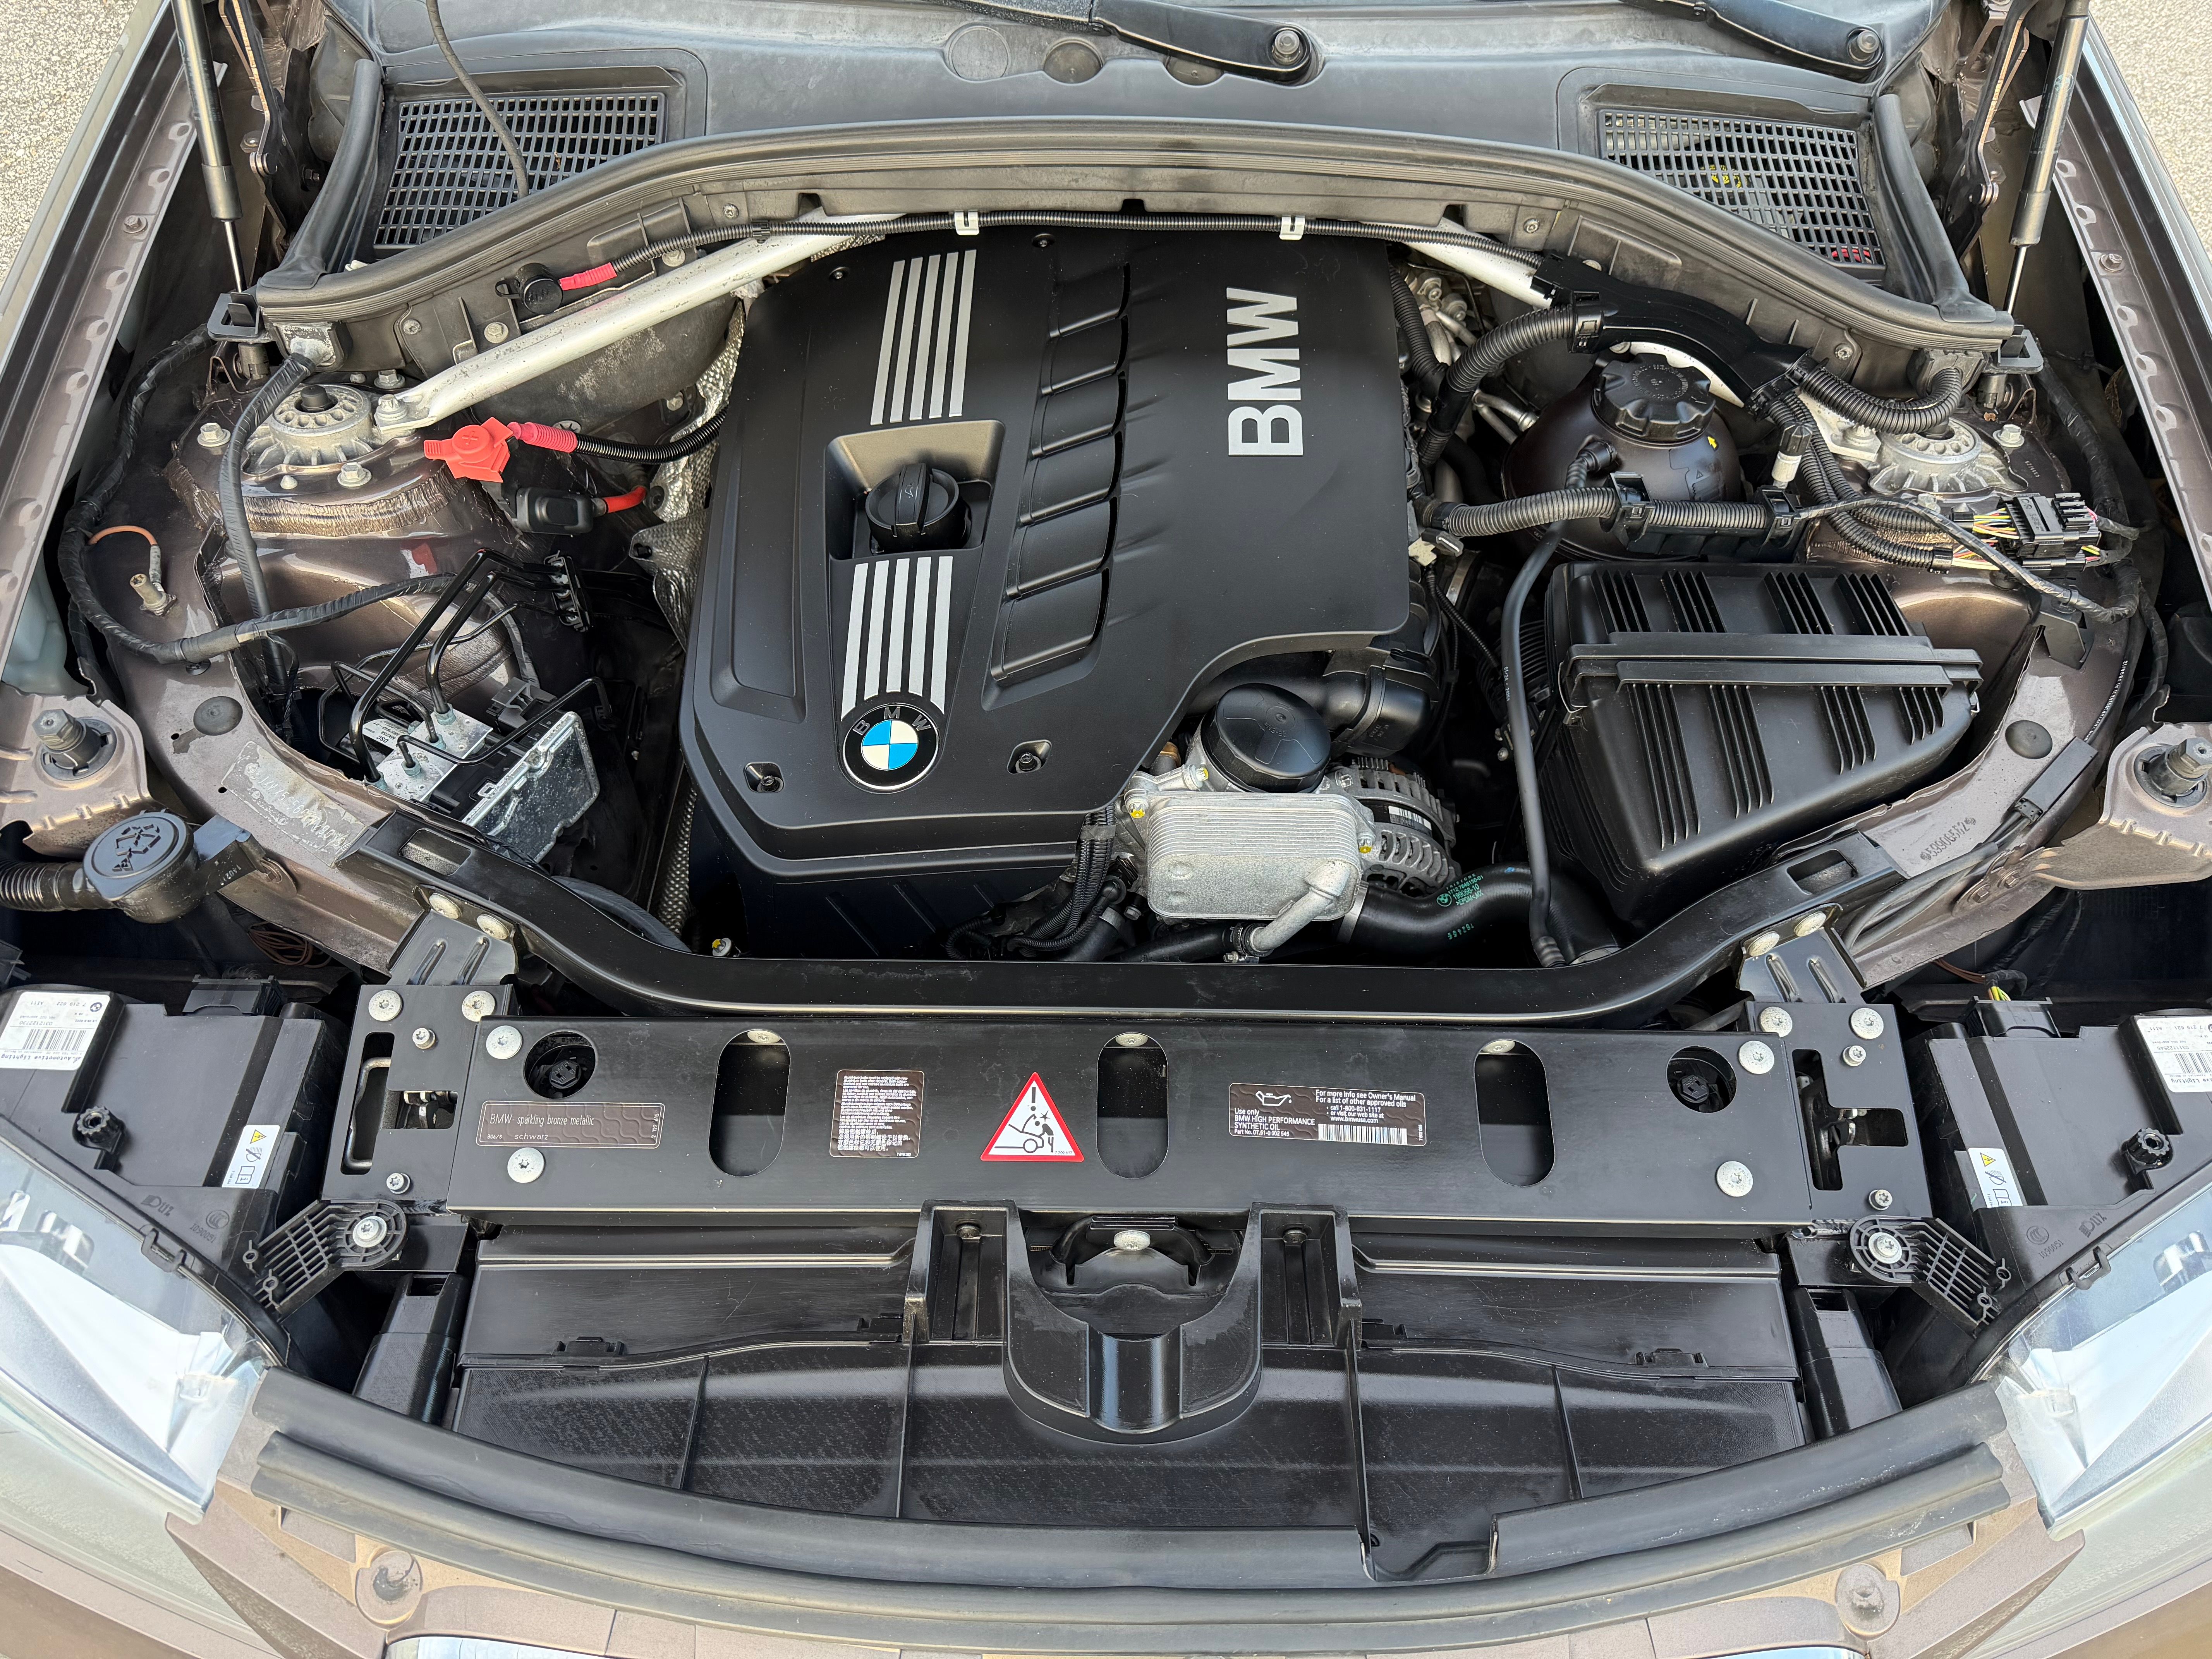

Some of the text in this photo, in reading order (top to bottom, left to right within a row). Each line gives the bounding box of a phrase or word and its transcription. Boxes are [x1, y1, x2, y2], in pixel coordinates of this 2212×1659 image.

[1227, 287, 1303, 457] BMW
[852, 706, 931, 736] BMW
[376, 735, 389, 744] DSC
[547, 1113, 567, 1125] bronze
[570, 1115, 594, 1126] metallic
[1268, 1116, 1315, 1125] PERFORMANCE
[1235, 1122, 1269, 1130] SYNTHETIC
